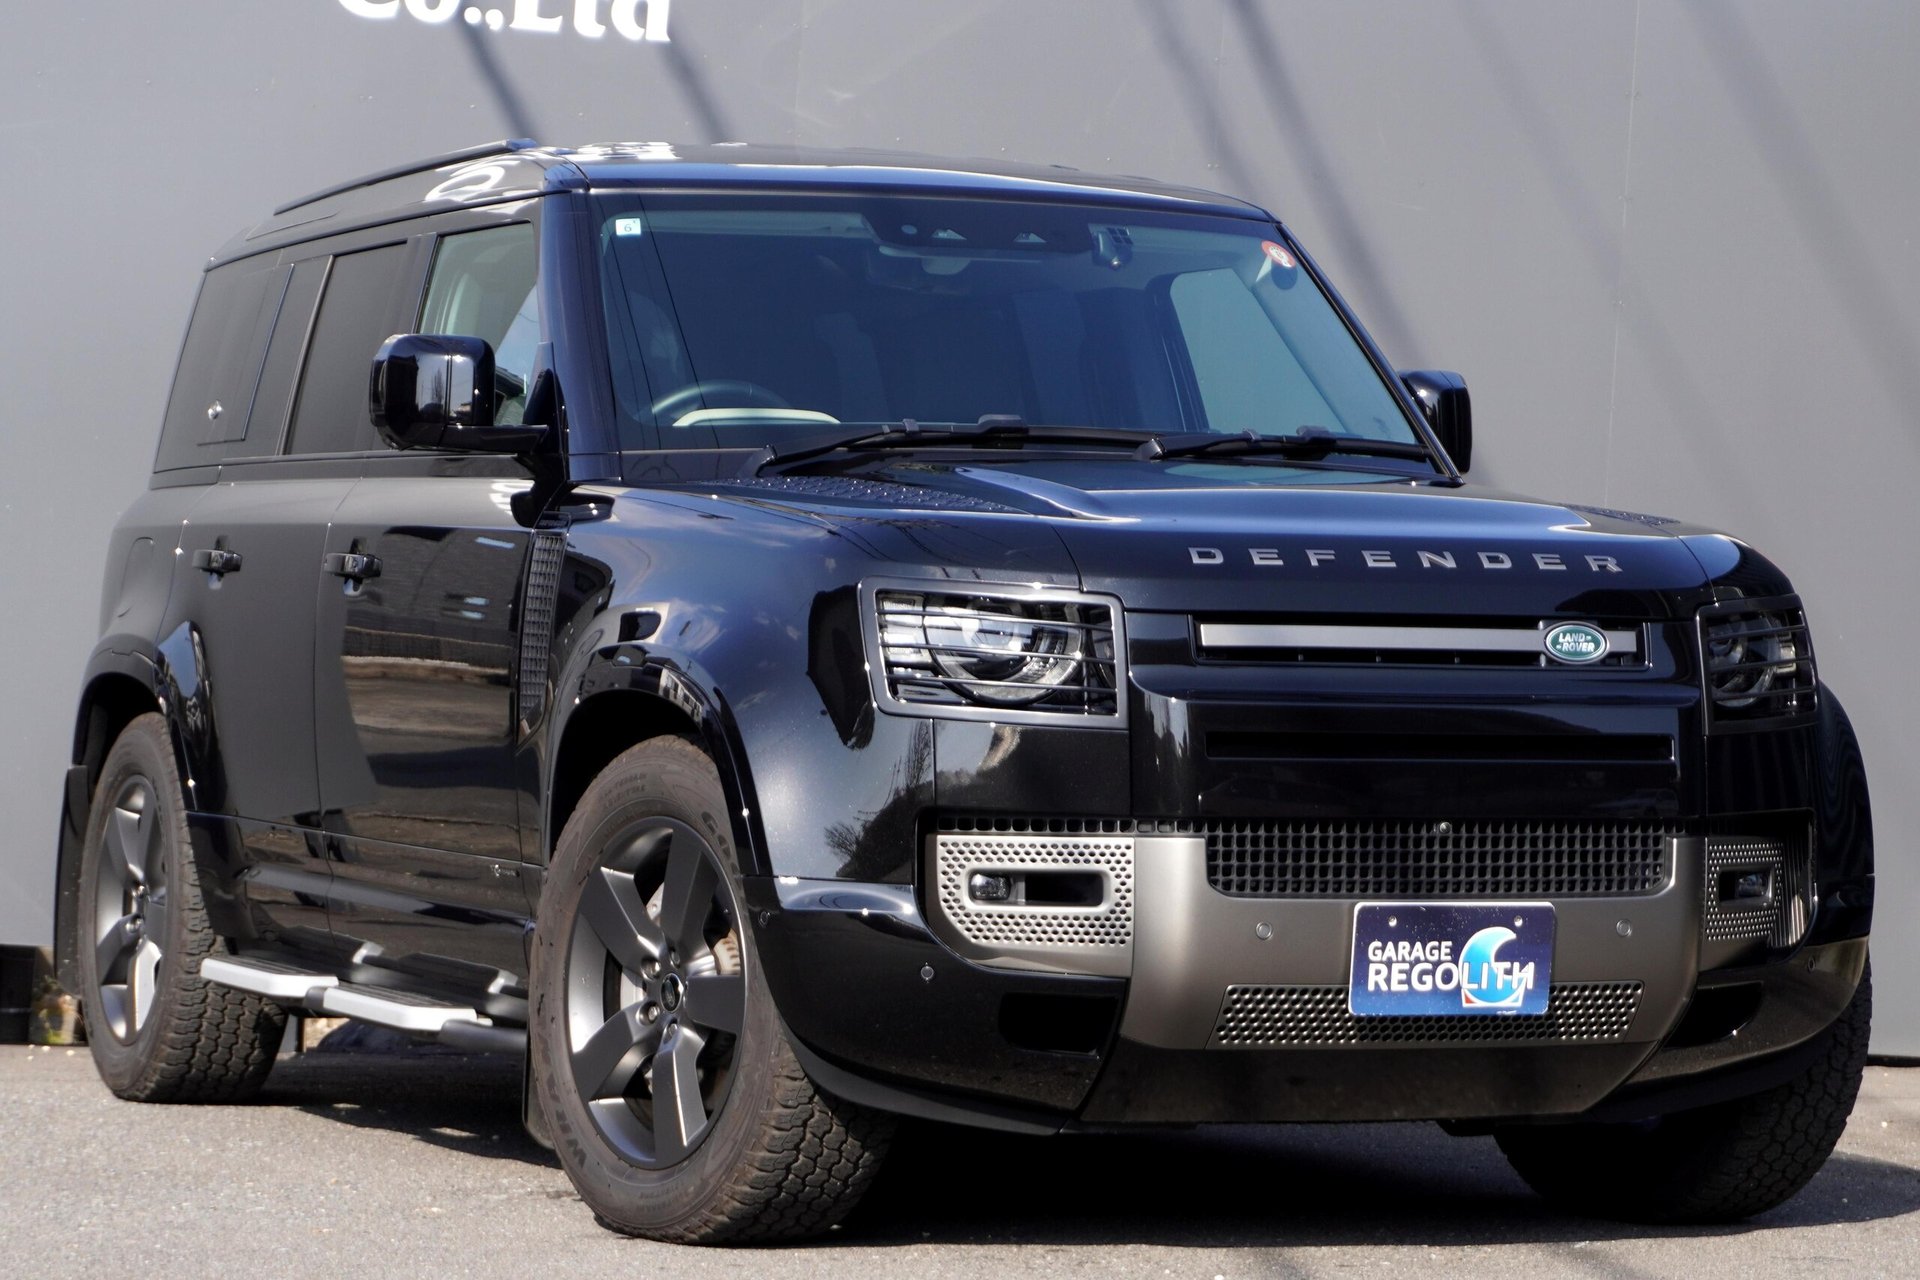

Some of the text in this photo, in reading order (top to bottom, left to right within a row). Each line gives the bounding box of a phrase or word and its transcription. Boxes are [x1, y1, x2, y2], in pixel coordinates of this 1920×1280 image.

[338, 0, 671, 42] .,td
[1187, 546, 1624, 572] DEFENDER
[1558, 632, 1586, 643] LAND
[1562, 642, 1596, 652] ROVER
[1367, 940, 1453, 961] GARAGE
[1367, 961, 1535, 992] REGOLITH
